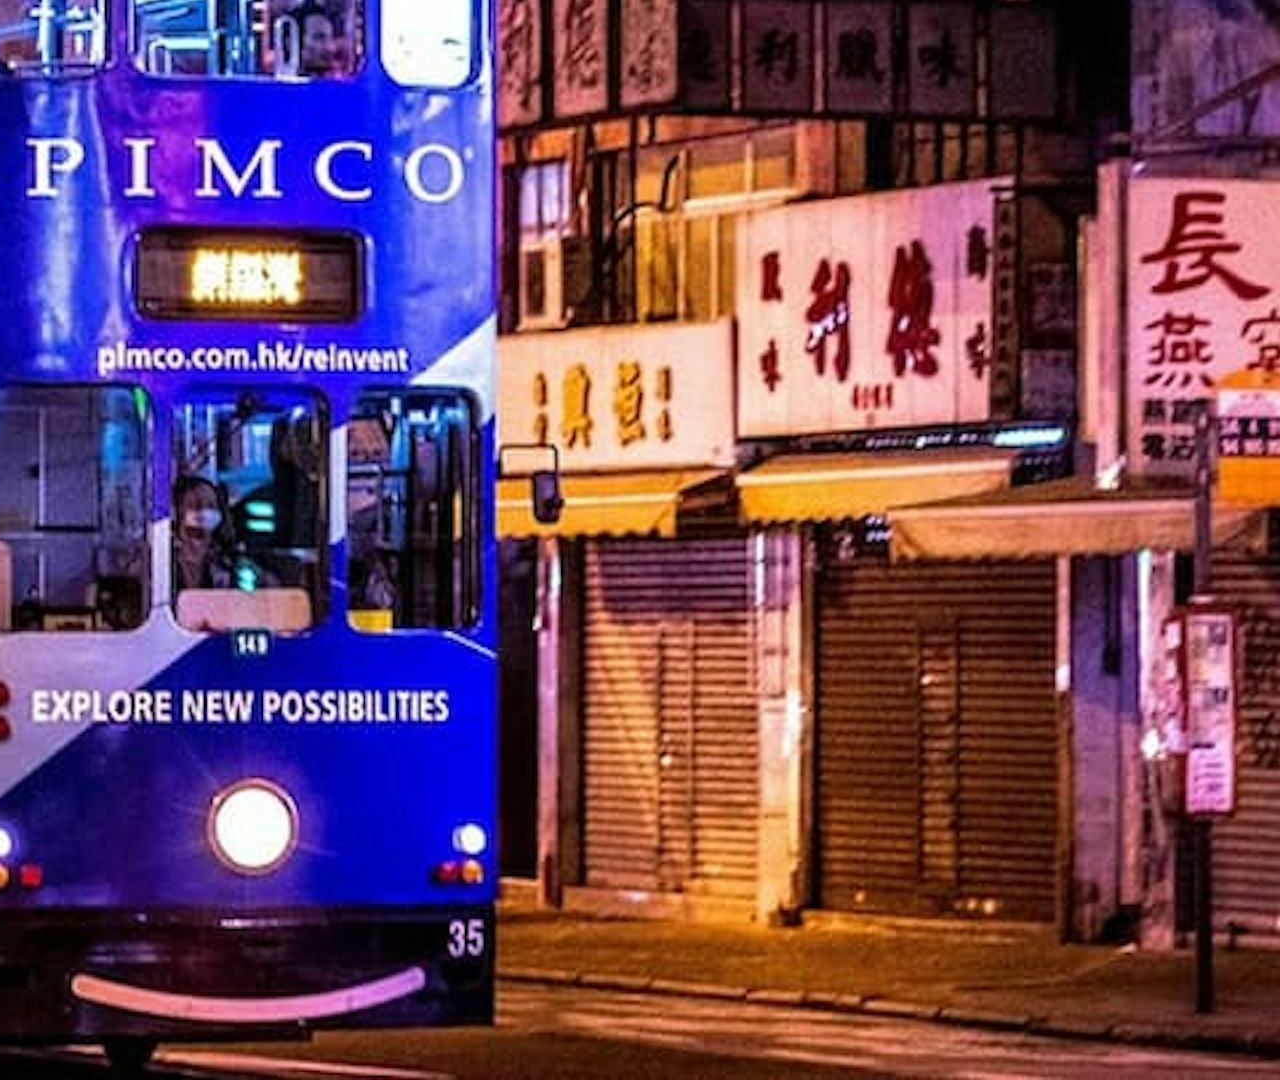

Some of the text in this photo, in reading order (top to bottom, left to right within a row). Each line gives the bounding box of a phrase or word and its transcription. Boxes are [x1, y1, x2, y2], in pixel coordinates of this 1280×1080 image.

[24, 137, 467, 203] PIMCO
[97, 340, 410, 377] pimco.com.hk/reinvent
[31, 689, 450, 723] EXPLORE NEW POSSIBILITIES
[447, 920, 485, 957] 35
